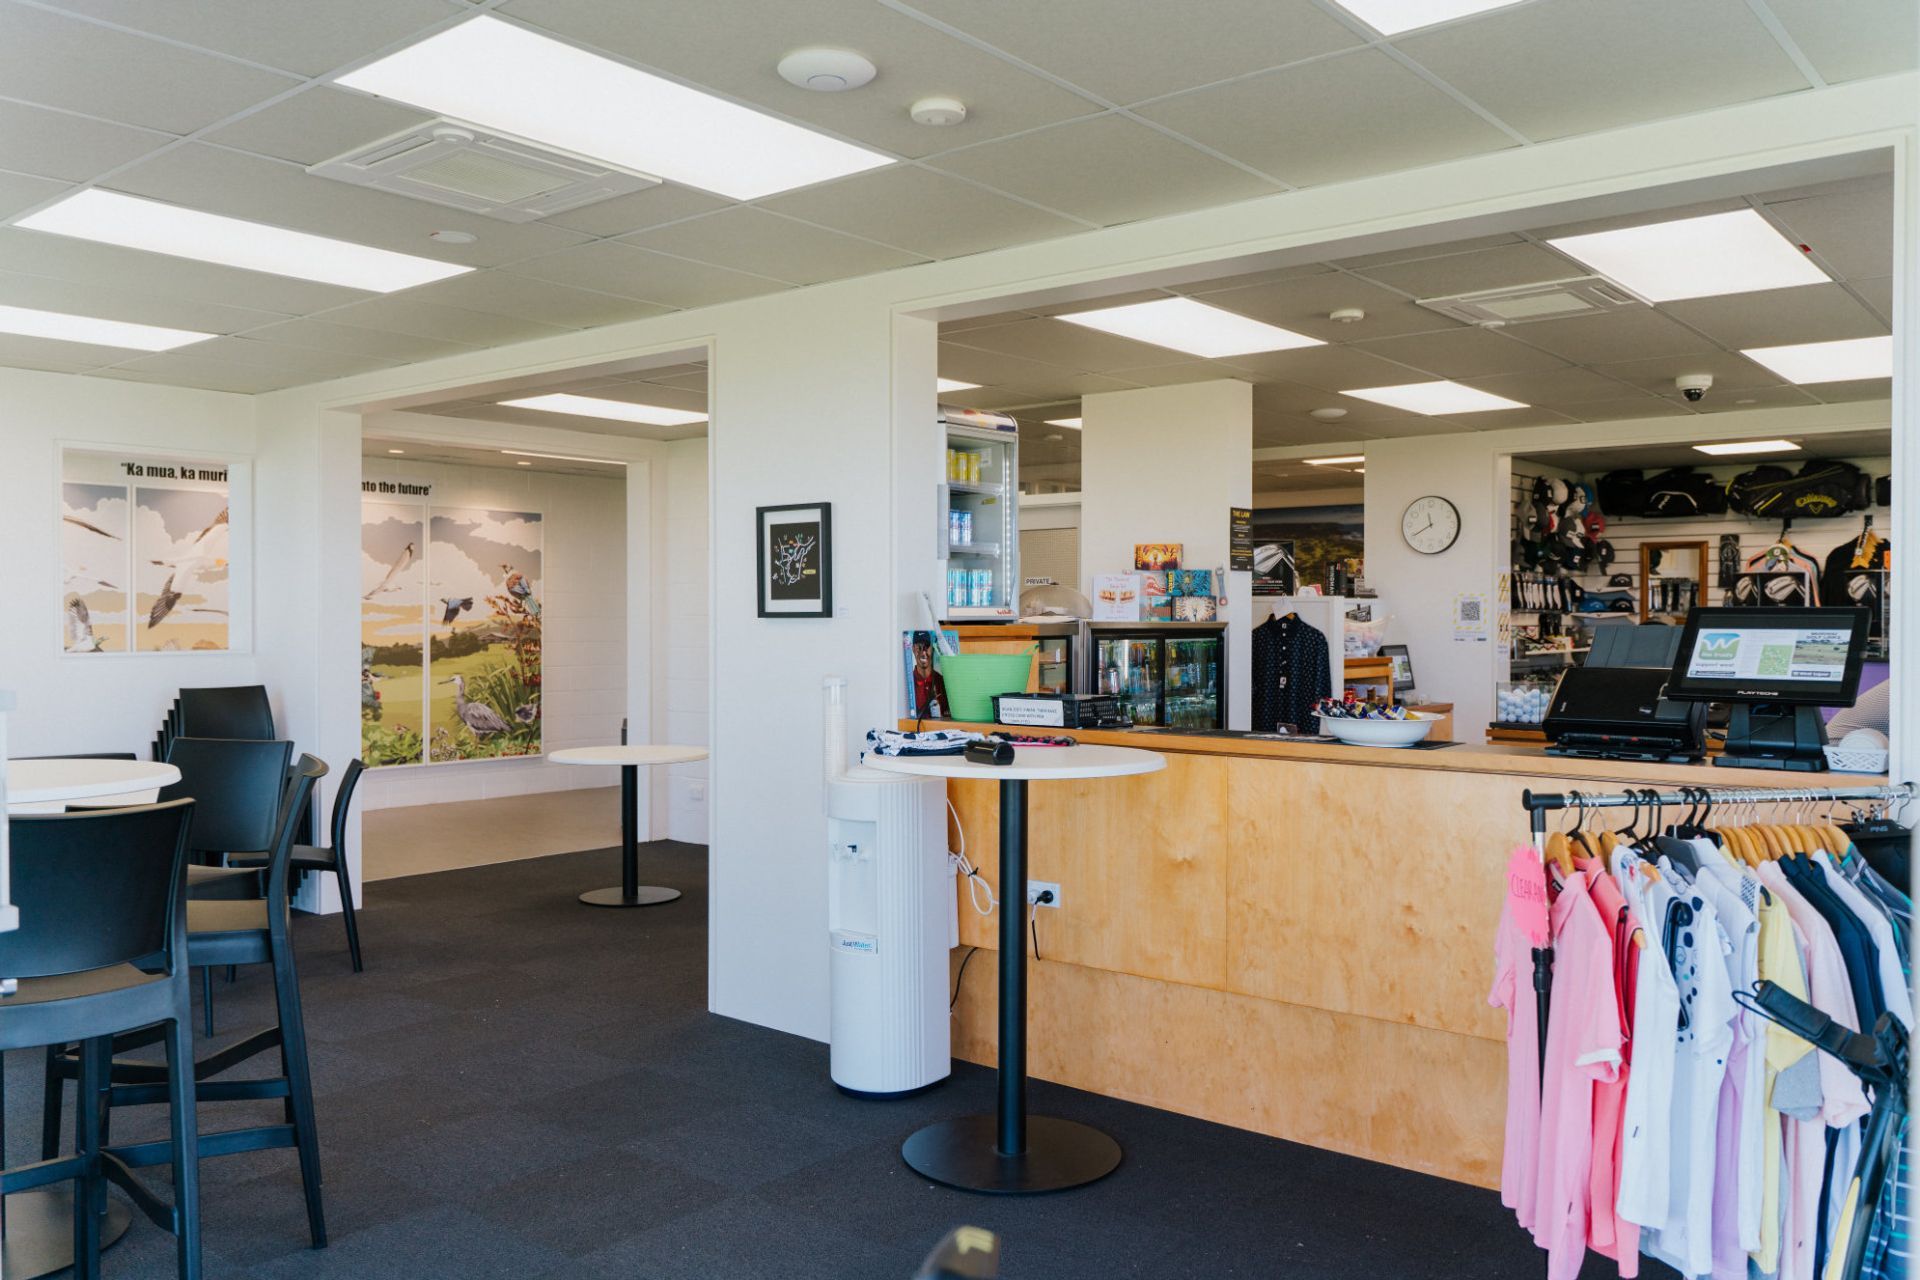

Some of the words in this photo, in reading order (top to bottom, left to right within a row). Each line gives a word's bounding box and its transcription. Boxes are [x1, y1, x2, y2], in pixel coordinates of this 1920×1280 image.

[147, 466, 178, 480] mua,
[181, 467, 195, 480] ka
[199, 470, 228, 482] muri
[379, 481, 396, 494] the
